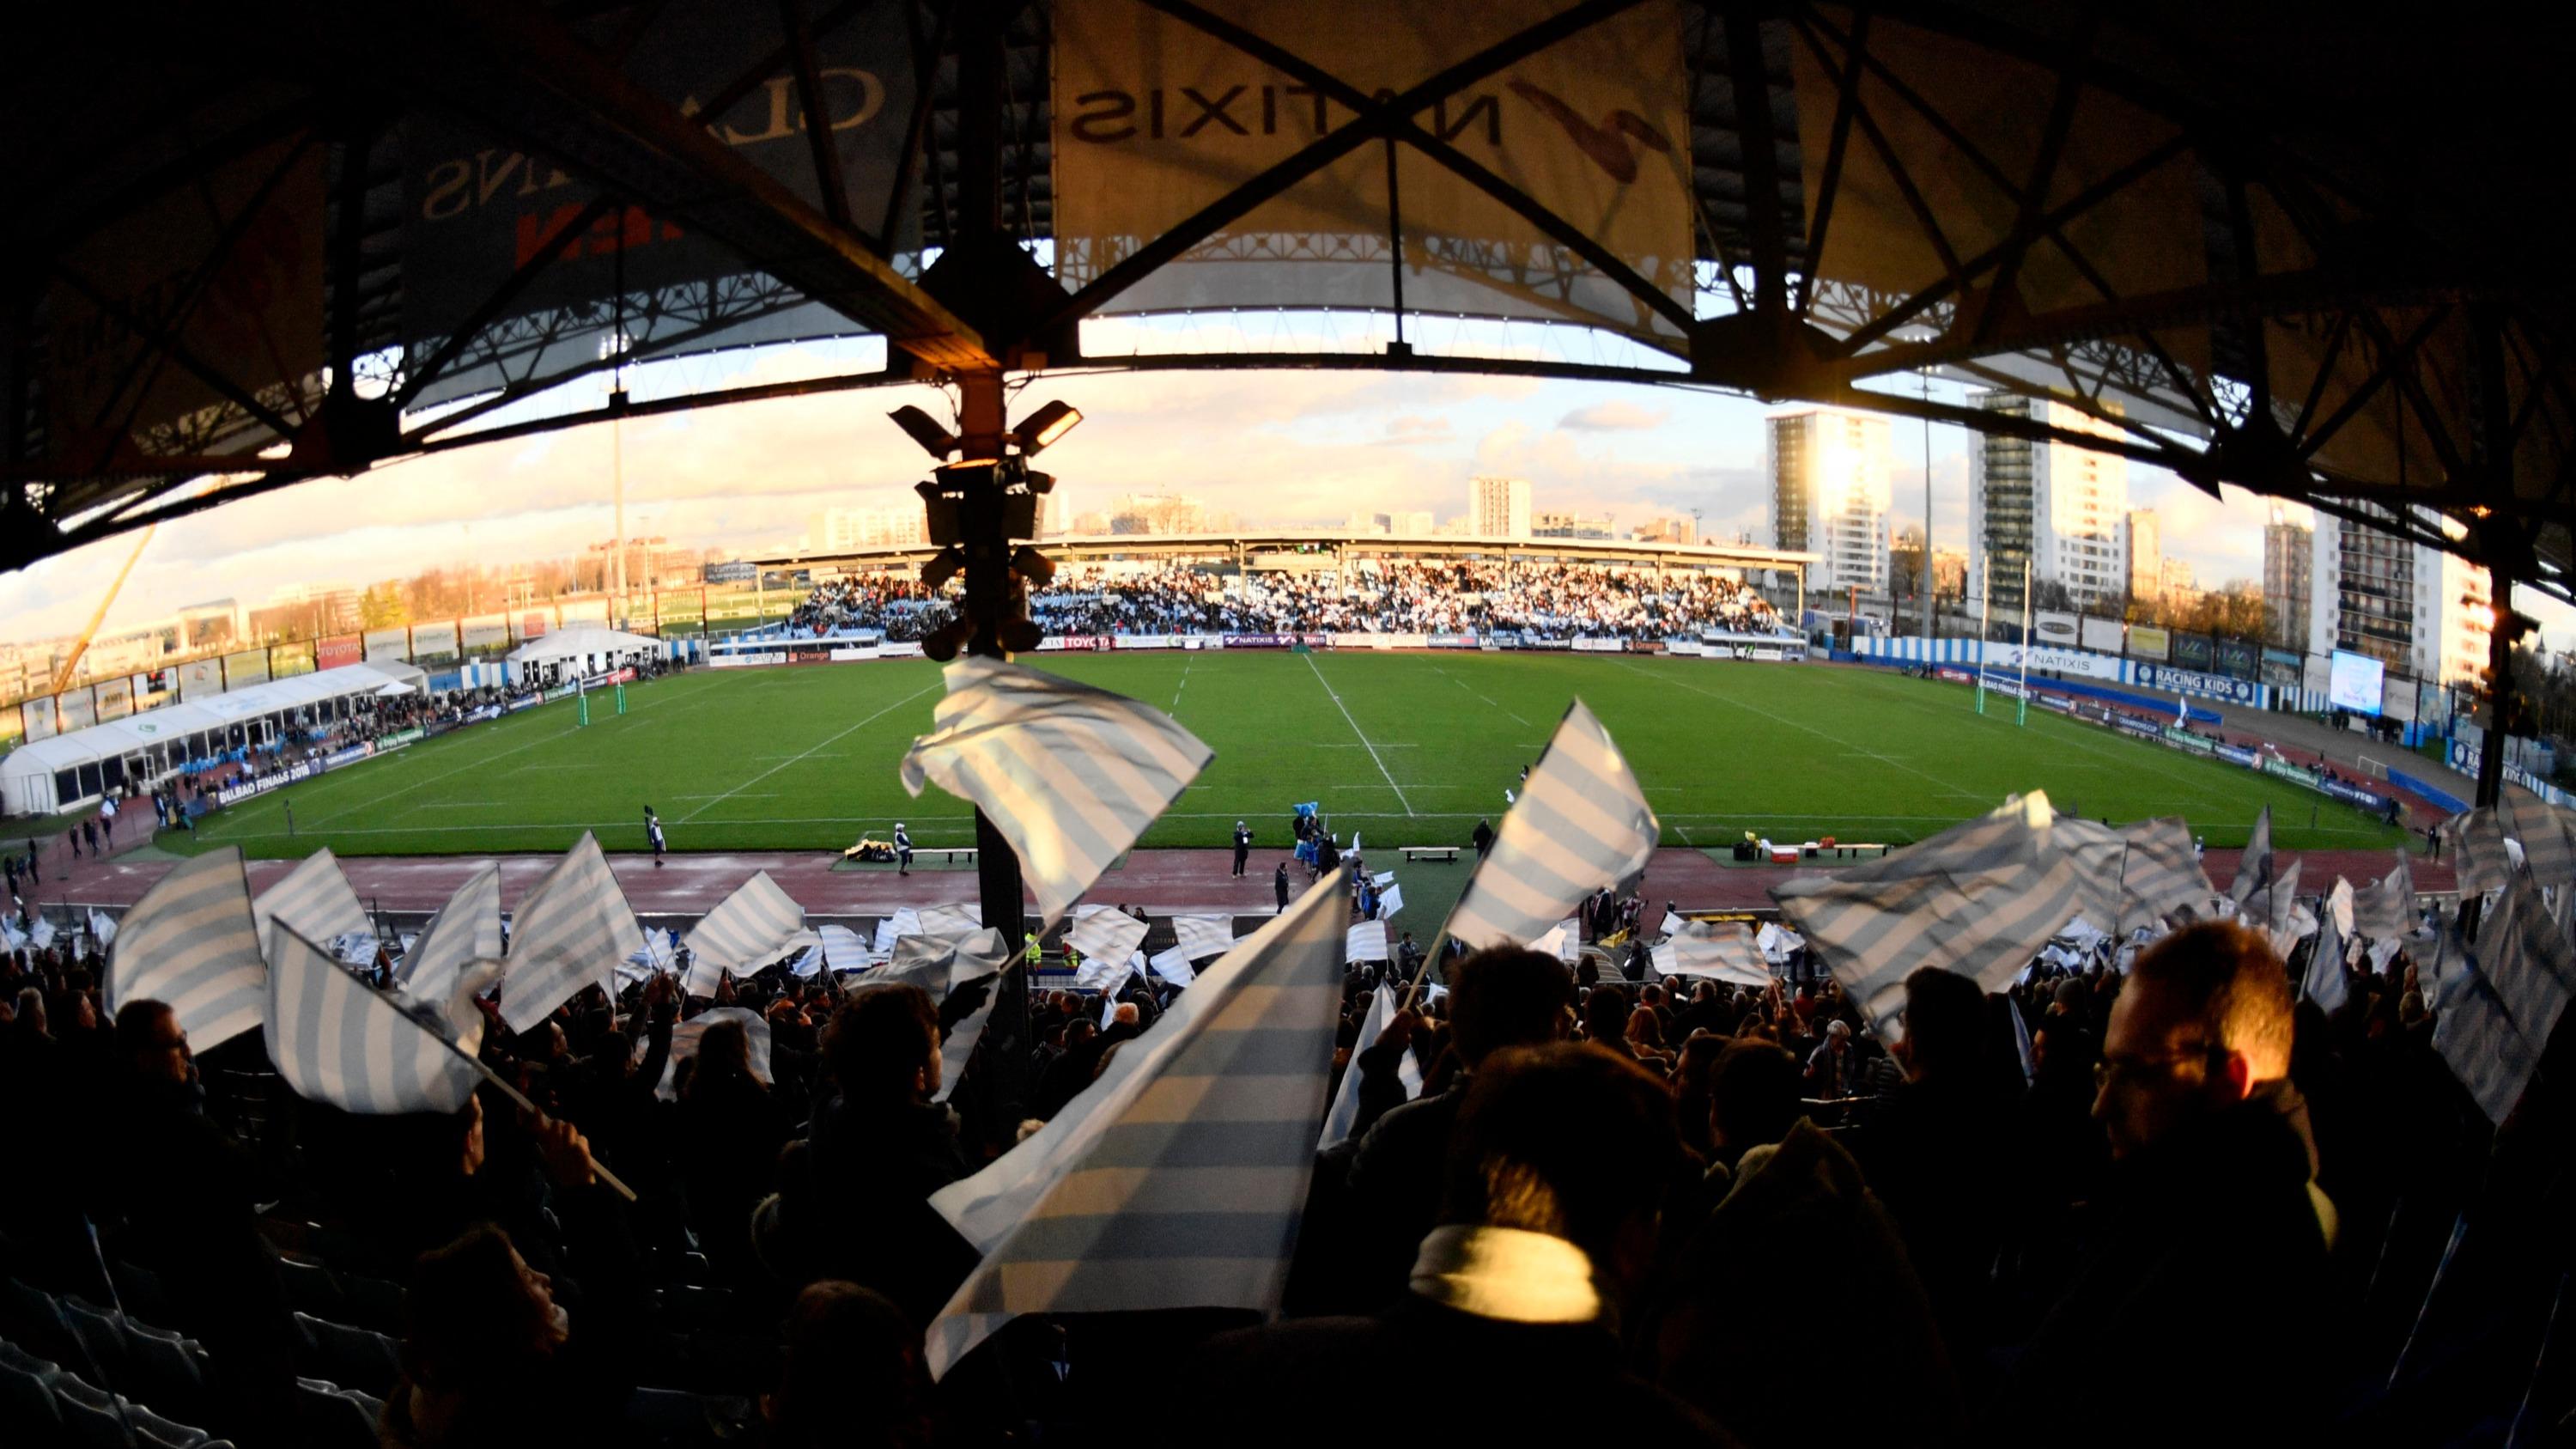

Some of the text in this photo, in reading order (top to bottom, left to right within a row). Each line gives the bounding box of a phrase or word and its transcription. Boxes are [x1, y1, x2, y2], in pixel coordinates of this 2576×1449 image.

[319, 643, 359, 657] TOYOTA
[1636, 641, 1664, 650] Orange
[799, 651, 829, 661] Orange
[2034, 654, 2091, 671] NATIXIS
[2155, 669, 2233, 694] RACING KIDS
[219, 764, 311, 804] BILBAO FINALS 2018
